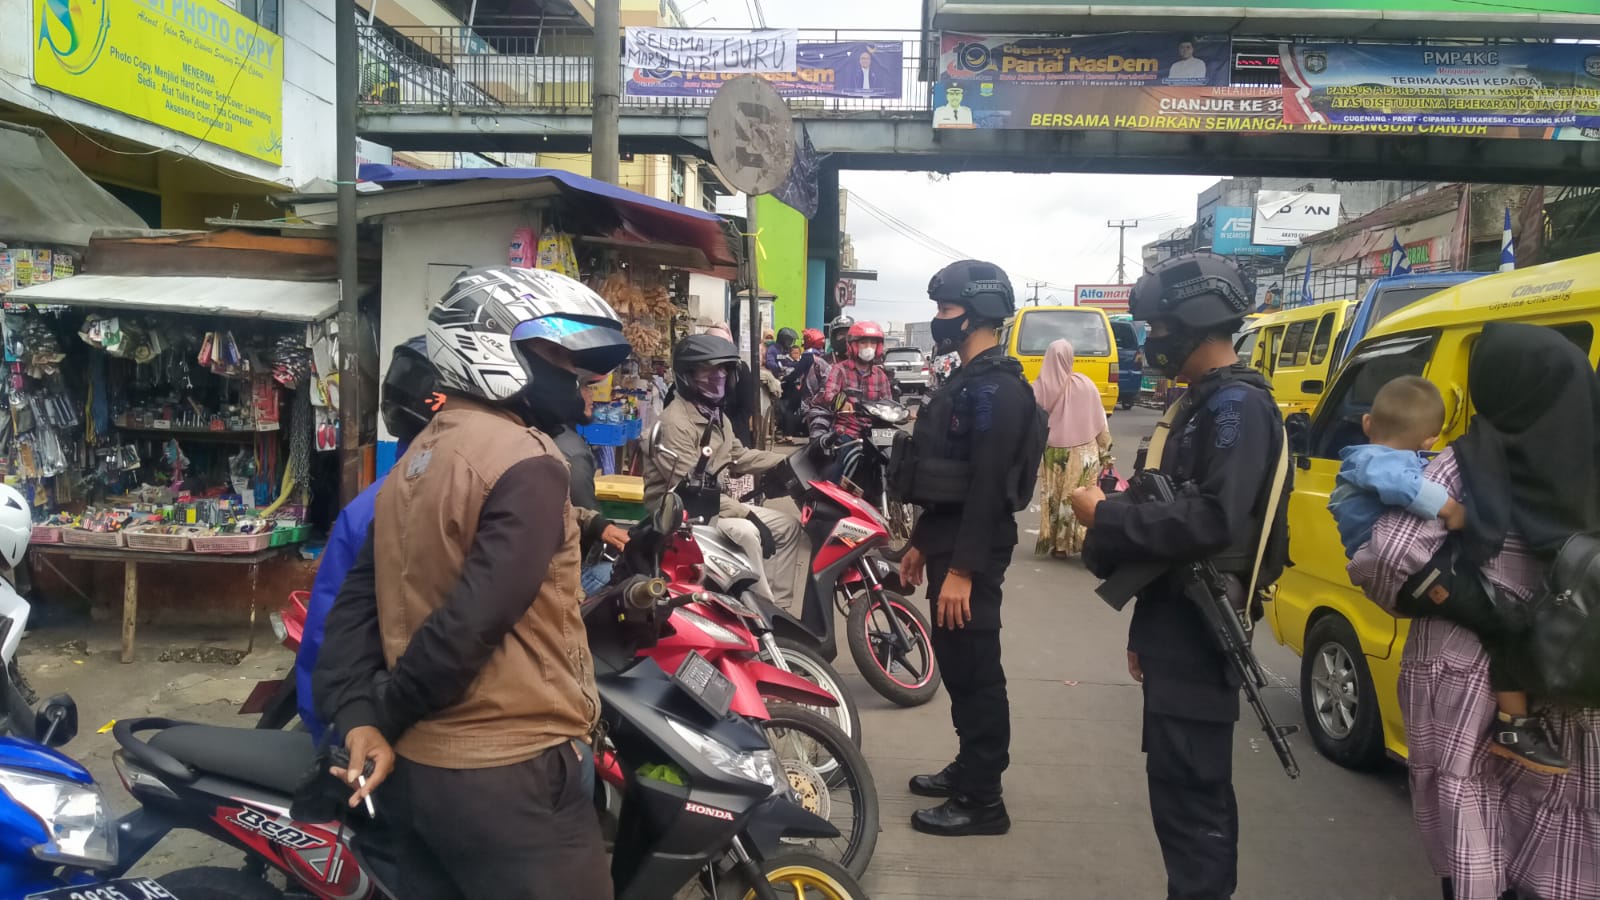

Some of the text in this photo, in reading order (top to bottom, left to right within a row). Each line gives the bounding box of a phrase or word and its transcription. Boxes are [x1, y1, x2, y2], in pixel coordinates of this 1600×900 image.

[172, 0, 275, 65] PHOTO COPY
[110, 45, 132, 64] Photo
[723, 35, 787, 72] GURU
[1423, 51, 1500, 66] PMP4KC
[1001, 53, 1159, 74] Partai NasDem
[1392, 76, 1480, 86] TERIMAKASIH
[1327, 85, 1374, 96] PANSUS
[1384, 86, 1417, 96] DPRD
[1418, 87, 1443, 96] DAN
[1160, 98, 1235, 112] CIANJUR
[1240, 99, 1263, 112] KE
[1332, 98, 1598, 111] ATAS DISETUJUINYA PEMEKARAN KOTA CIPNAS
[1030, 112, 1111, 128] BERSAMA
[1114, 115, 1201, 130] HADIRKAN
[1343, 115, 1387, 123] CUGENANG
[1392, 115, 1418, 123] PACET
[1422, 115, 1456, 123] CIPANAS
[1462, 116, 1507, 124] SUKARESMI
[1512, 116, 1553, 124] CIKALONG
[1080, 289, 1130, 298] Alfamart
[684, 801, 734, 821] HONDA
